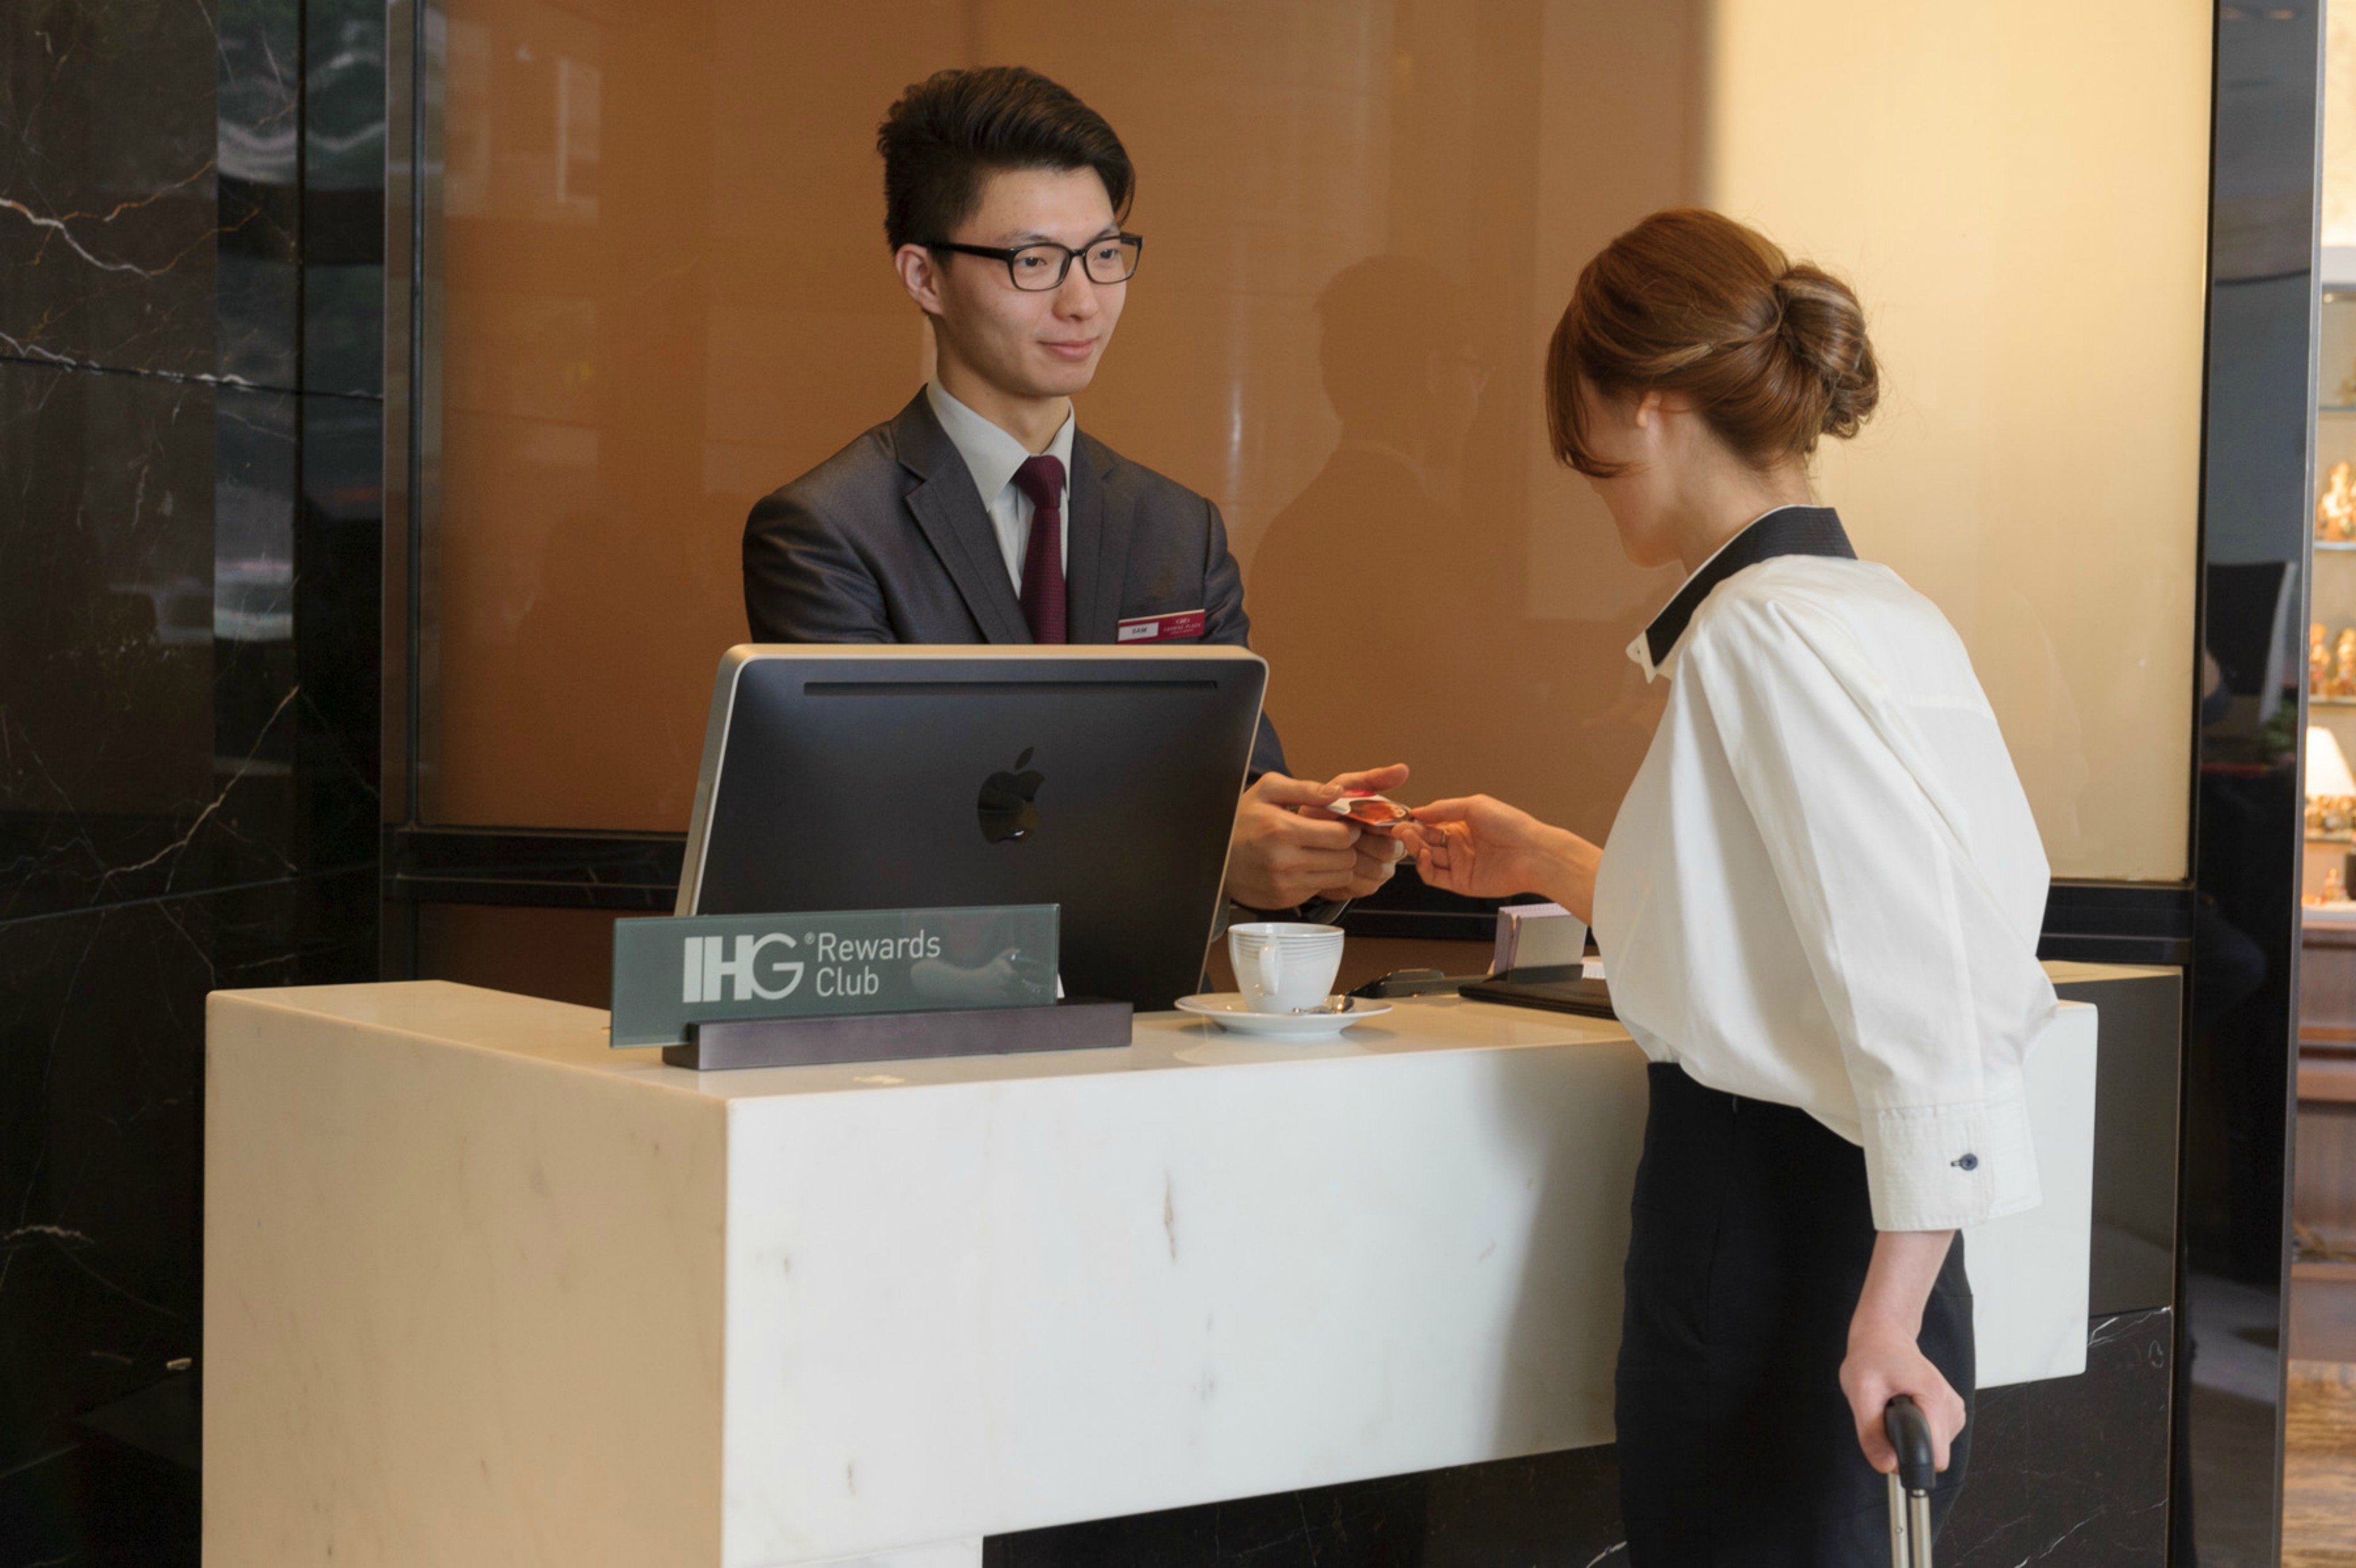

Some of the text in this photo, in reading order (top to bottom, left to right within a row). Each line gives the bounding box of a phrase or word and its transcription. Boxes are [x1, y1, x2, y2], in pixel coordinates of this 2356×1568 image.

[683, 929, 941, 1003] IHG Rewards
[817, 966, 879, 997] Club
